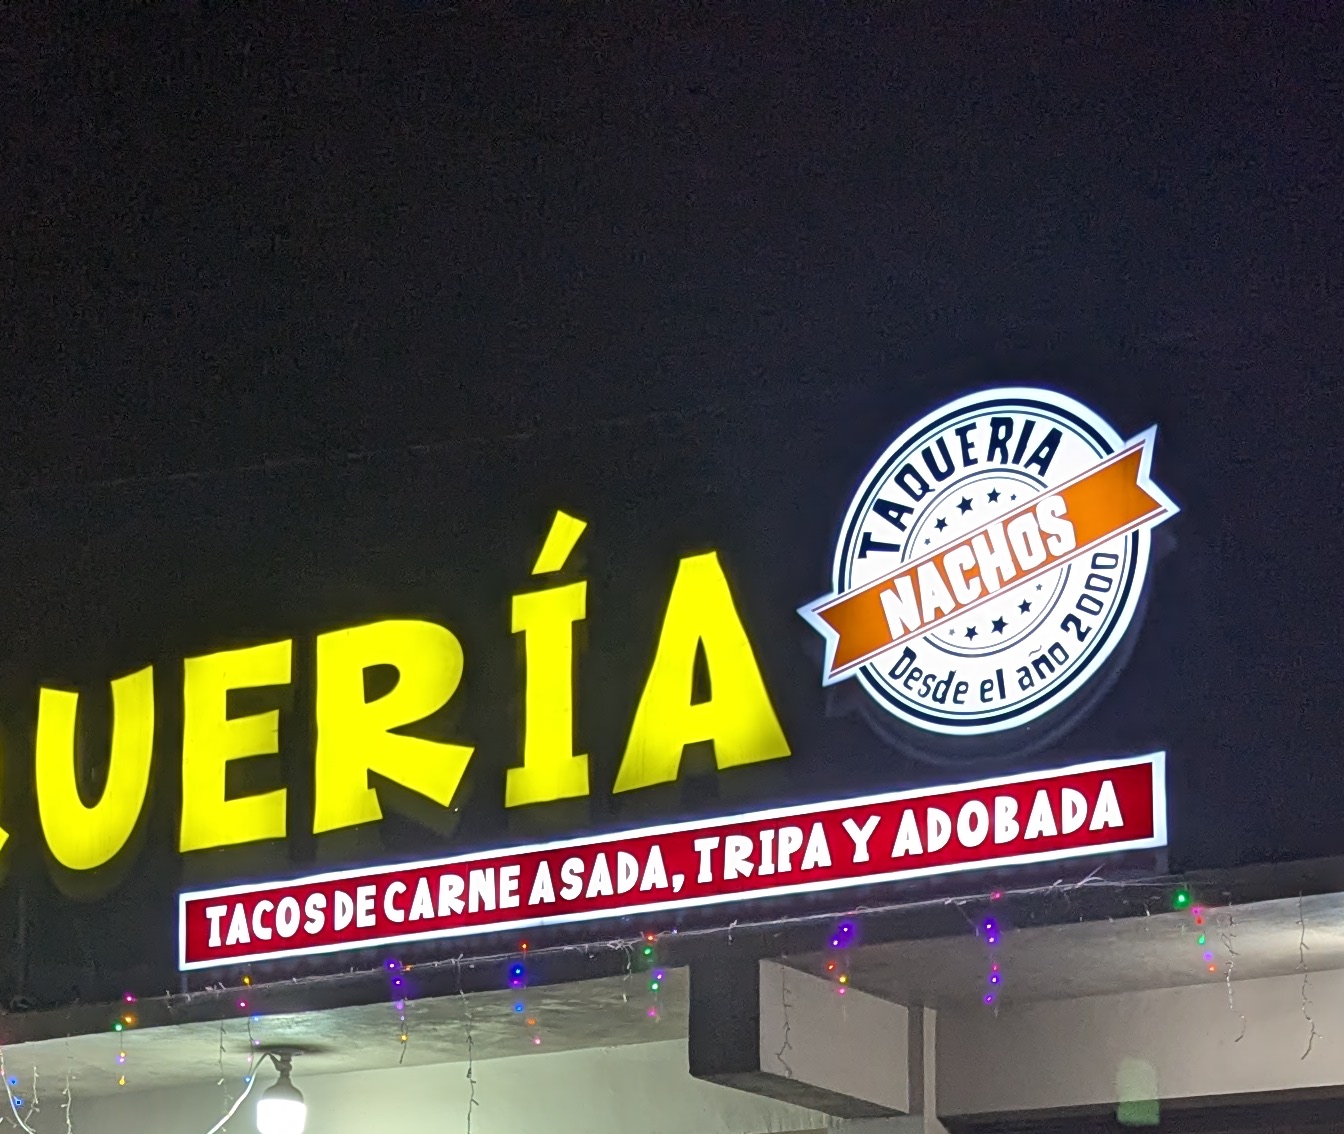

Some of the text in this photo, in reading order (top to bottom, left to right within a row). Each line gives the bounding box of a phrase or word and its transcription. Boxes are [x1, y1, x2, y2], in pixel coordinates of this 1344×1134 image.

[857, 415, 1064, 560] TAQUERIA
[878, 494, 1077, 642] NACHOS
[887, 551, 1120, 705] Desde el año 2000
[204, 779, 1126, 949] TACOS DE CARNE ASADA, TRIPA Y ADOBADA
